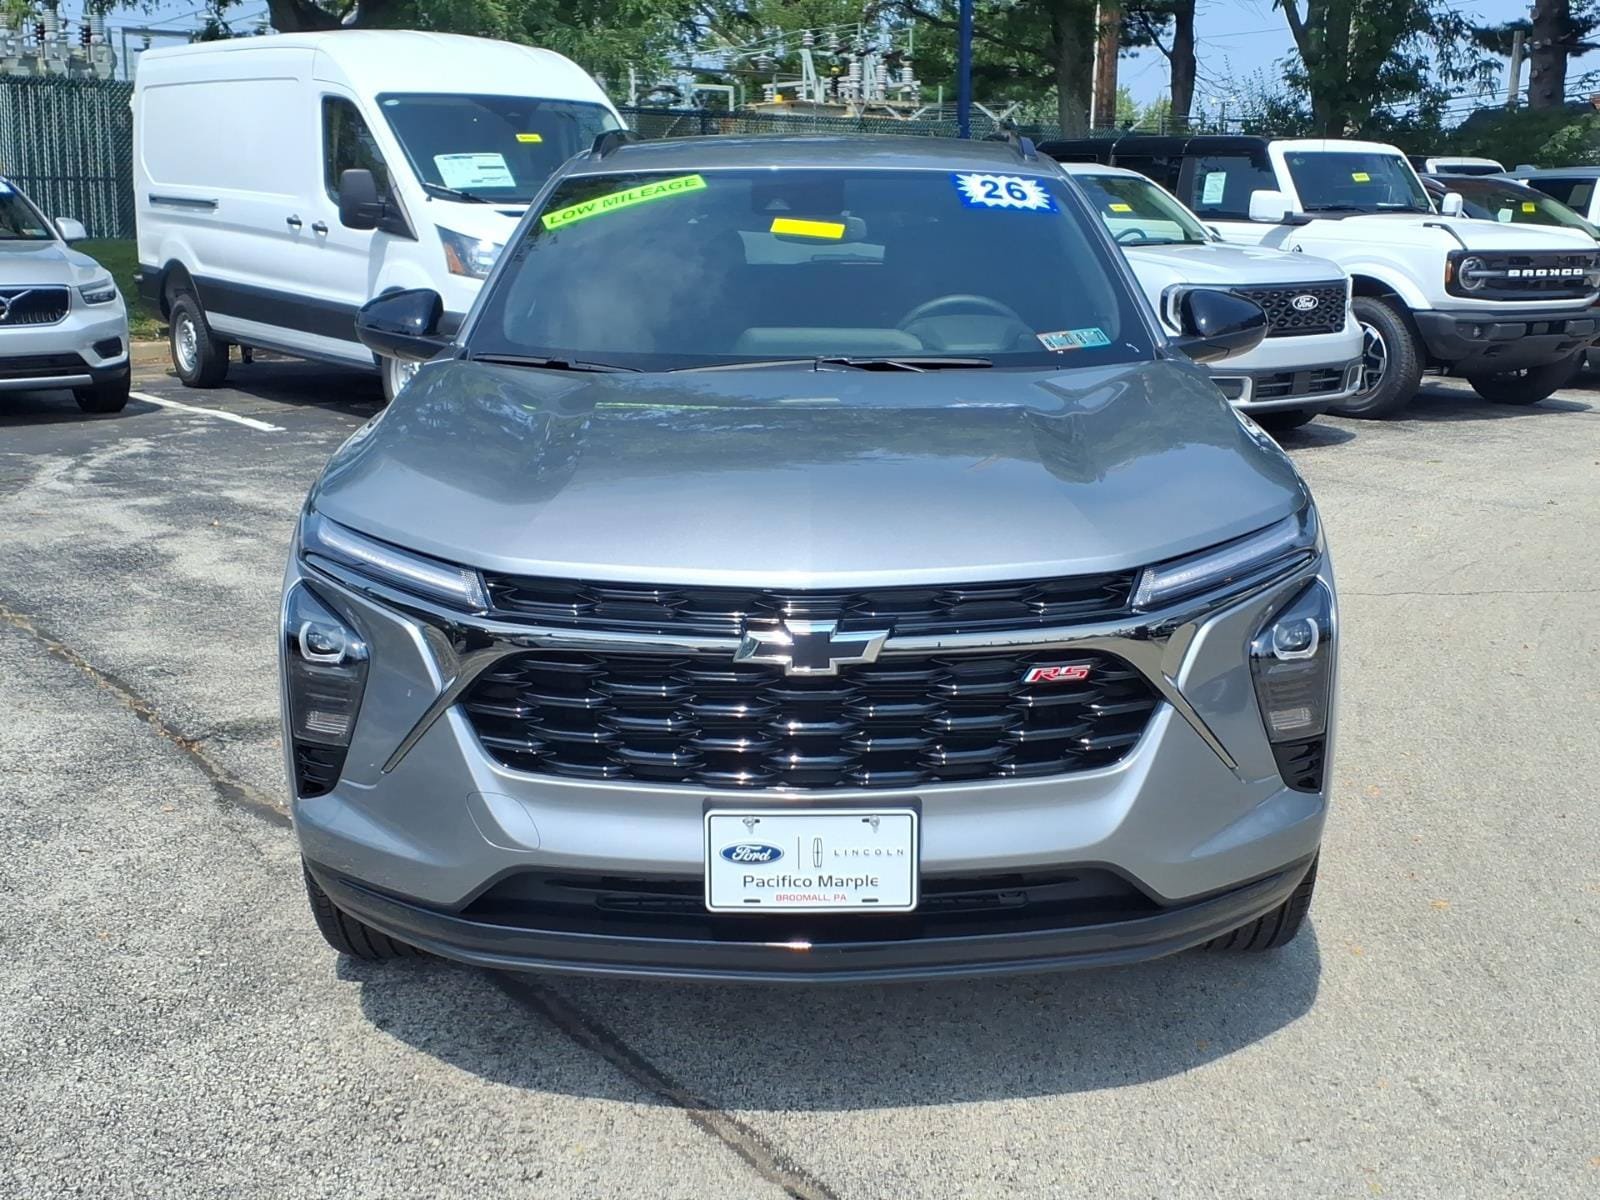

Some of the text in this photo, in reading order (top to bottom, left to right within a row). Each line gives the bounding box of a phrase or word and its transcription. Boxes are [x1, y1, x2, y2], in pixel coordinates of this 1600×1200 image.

[980, 180, 1028, 201] 26
[550, 177, 698, 225] LOW MILEAGE
[1508, 268, 1583, 277] BRONCO
[1026, 664, 1091, 682] RS
[729, 845, 774, 862] Ford
[833, 848, 904, 857] LINCOLN
[742, 874, 879, 890] Pacifico Marple
[833, 893, 847, 902] PA
